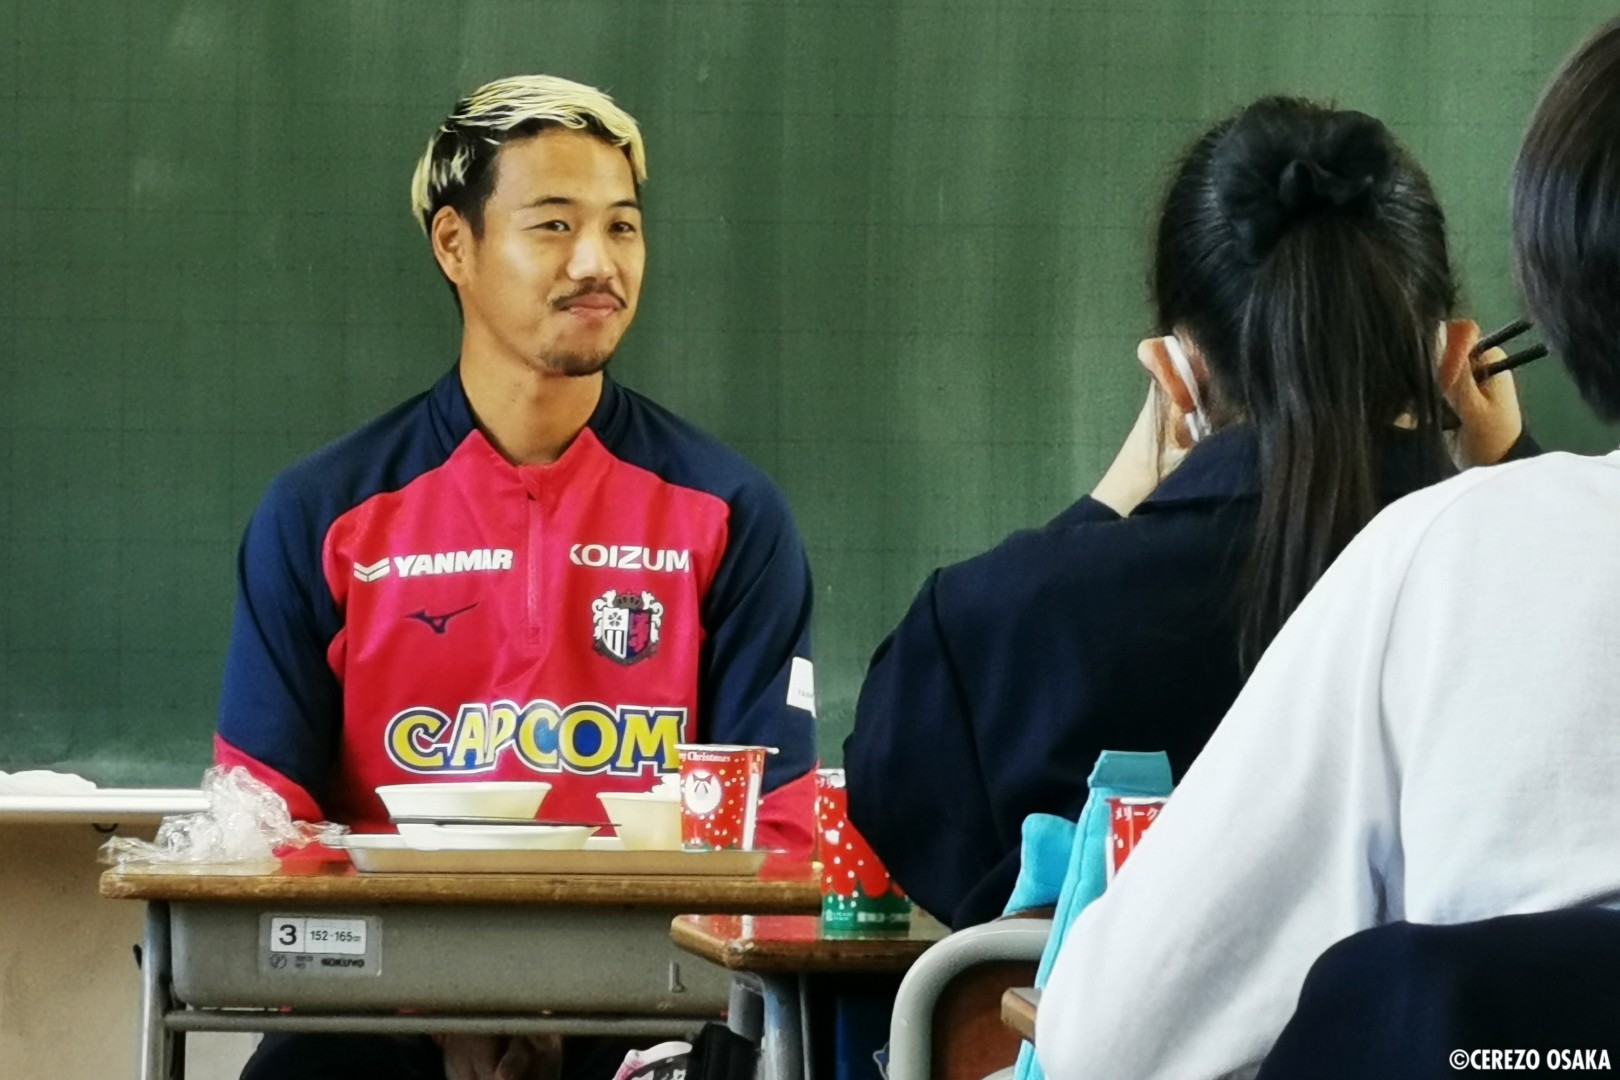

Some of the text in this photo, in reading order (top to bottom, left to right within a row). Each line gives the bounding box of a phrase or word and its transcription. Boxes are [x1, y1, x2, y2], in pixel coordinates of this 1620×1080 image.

[394, 549, 514, 578] YANMAR
[384, 699, 687, 777] CAPCOM
[279, 924, 297, 946] 3
